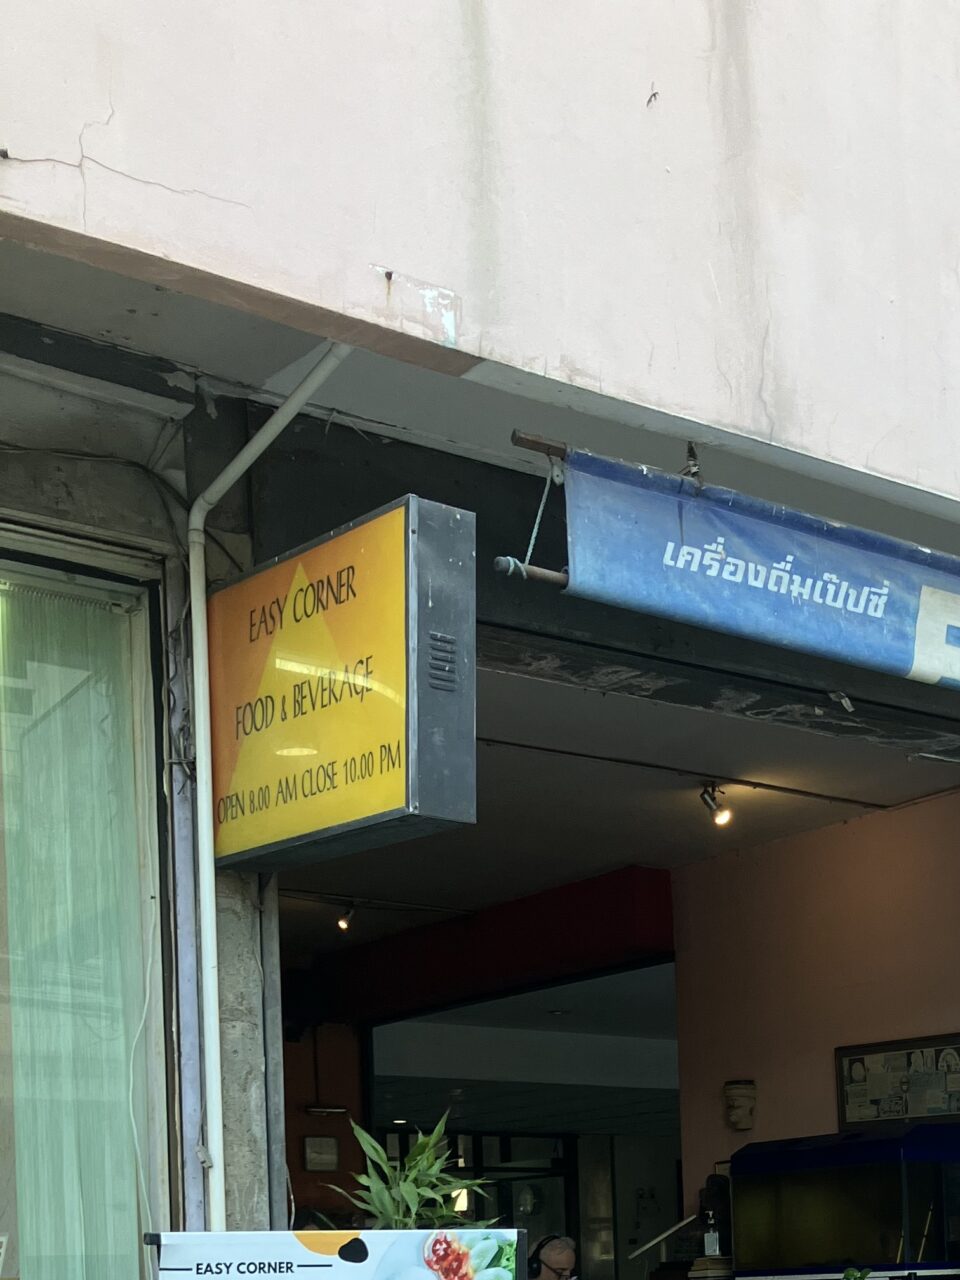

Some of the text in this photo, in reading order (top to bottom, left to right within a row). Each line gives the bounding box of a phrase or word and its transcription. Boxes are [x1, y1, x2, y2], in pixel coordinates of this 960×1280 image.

[250, 565, 356, 643] EASY CORNER
[663, 536, 889, 618] เครื่องดื่มเป๊ปซี่
[236, 656, 373, 740] FOOD & BEVERAGE
[217, 739, 401, 824] OPEN 8.00 AM CLOSE 10.00 PM
[196, 1262, 294, 1274] EASY CORNER
